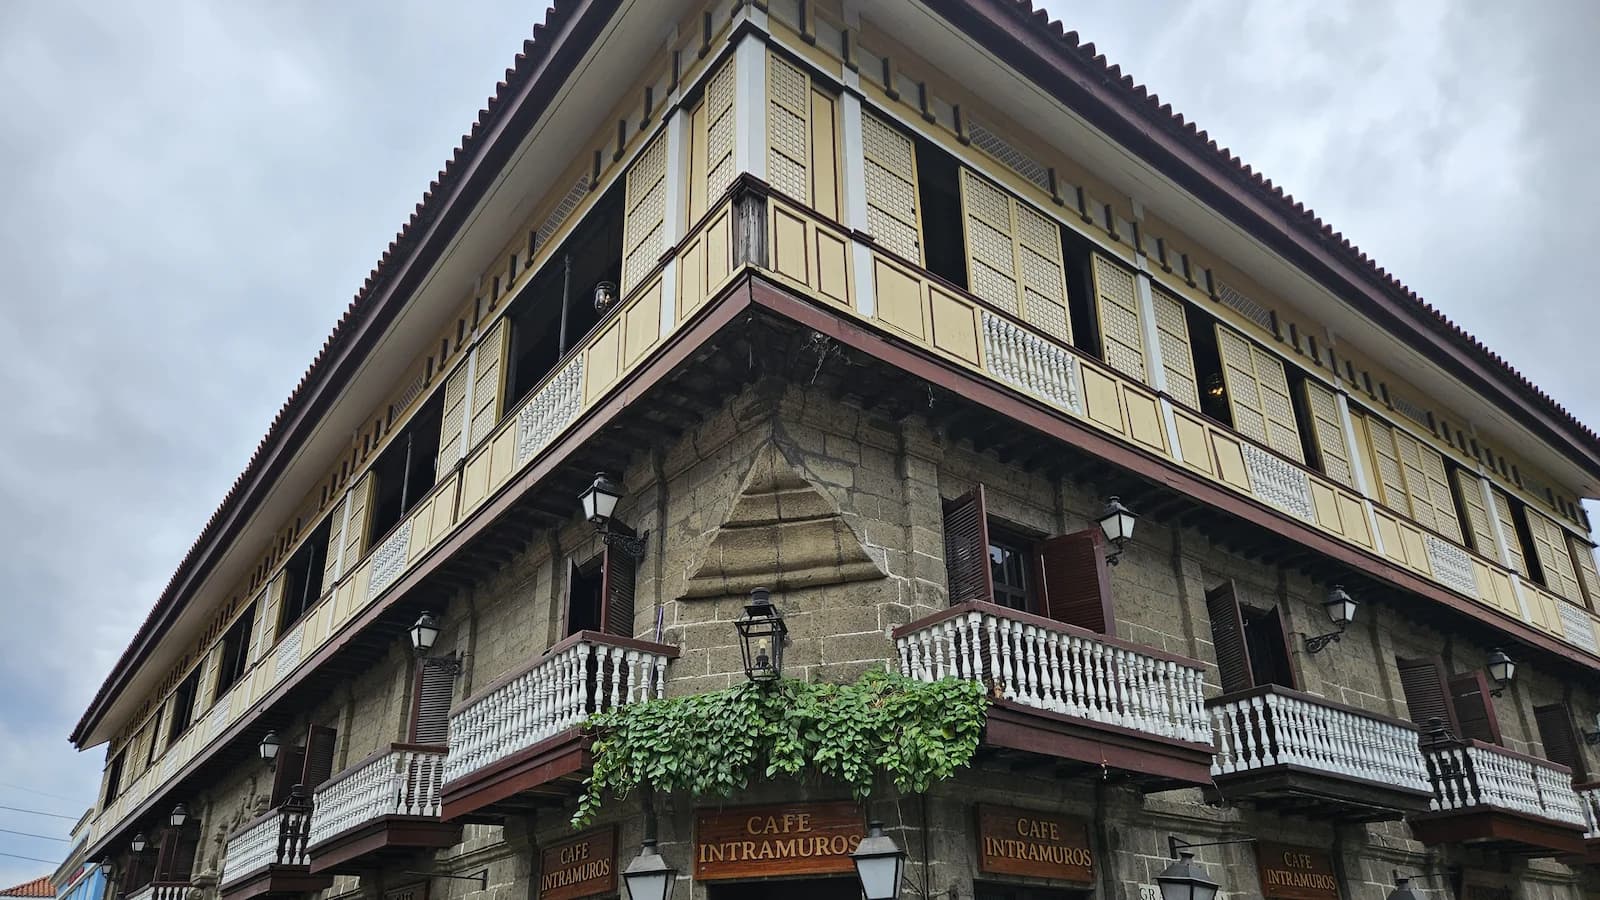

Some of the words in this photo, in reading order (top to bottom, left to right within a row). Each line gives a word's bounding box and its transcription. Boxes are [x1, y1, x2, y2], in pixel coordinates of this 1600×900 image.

[747, 814, 811, 835] CAFE
[1017, 818, 1059, 840] CAFE
[560, 842, 588, 864] CAFE
[700, 835, 860, 863] INTRAMUROS
[984, 837, 1092, 867] INTRAMUROS
[1283, 851, 1312, 869] CAFE
[541, 858, 610, 891] INTRAMUROS
[1267, 869, 1335, 890] INTRAMUROS
